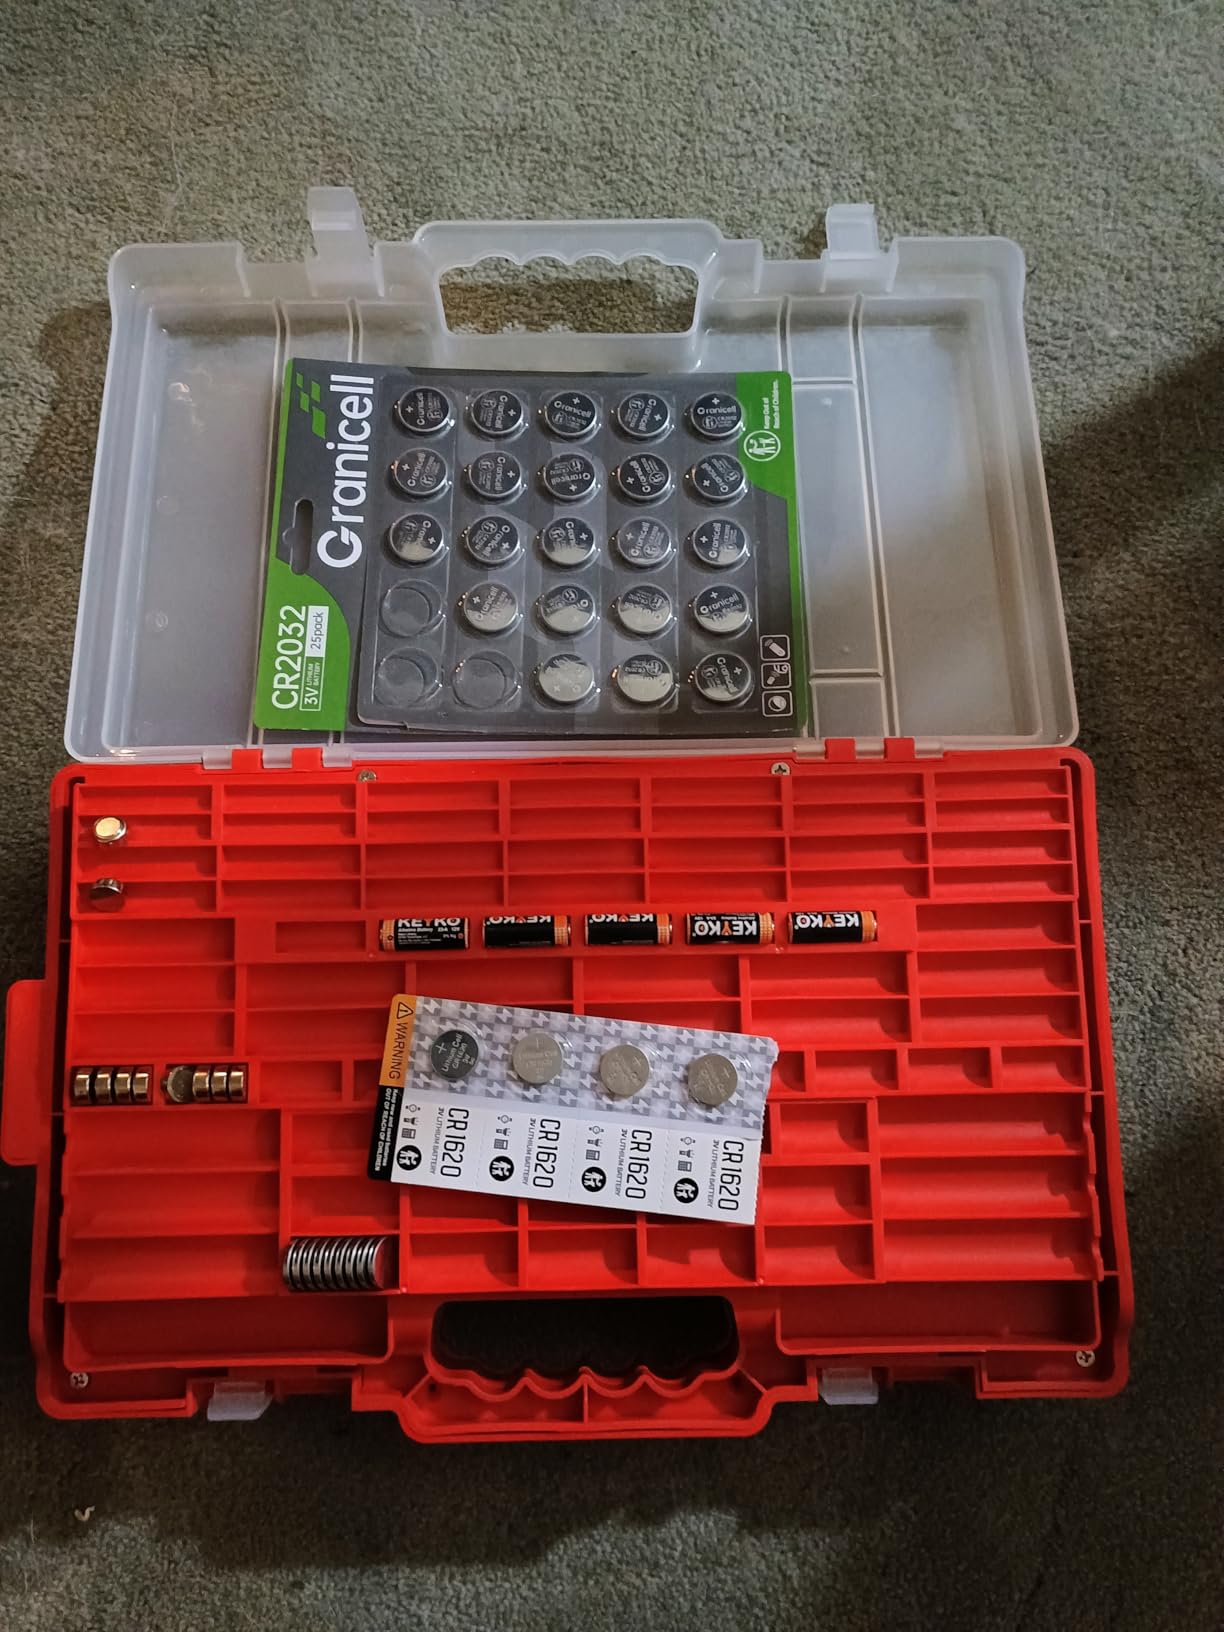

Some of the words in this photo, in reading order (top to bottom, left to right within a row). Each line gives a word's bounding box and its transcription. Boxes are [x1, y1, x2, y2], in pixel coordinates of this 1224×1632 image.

[317, 374, 374, 568] Granicell
[310, 612, 325, 650] 25pack
[271, 605, 306, 709] CR2032
[304, 687, 319, 705] 3V
[694, 920, 757, 936] KEYKO
[388, 1022, 408, 1080] WARNING
[434, 1115, 443, 1144] LITHIUM
[440, 1107, 470, 1178] CR1620
[526, 1126, 535, 1155] LITHIUM
[430, 1144, 439, 1175] BATTERY
[533, 1118, 561, 1188] CR1620
[617, 1137, 627, 1166] LITHIUM
[625, 1129, 653, 1200] CR1620
[709, 1149, 719, 1177] LITHIUM
[522, 1154, 531, 1186] BATTERY
[614, 1166, 623, 1197] BATTERY
[718, 1140, 745, 1211] CR1620
[706, 1177, 715, 1208] BATTERY
